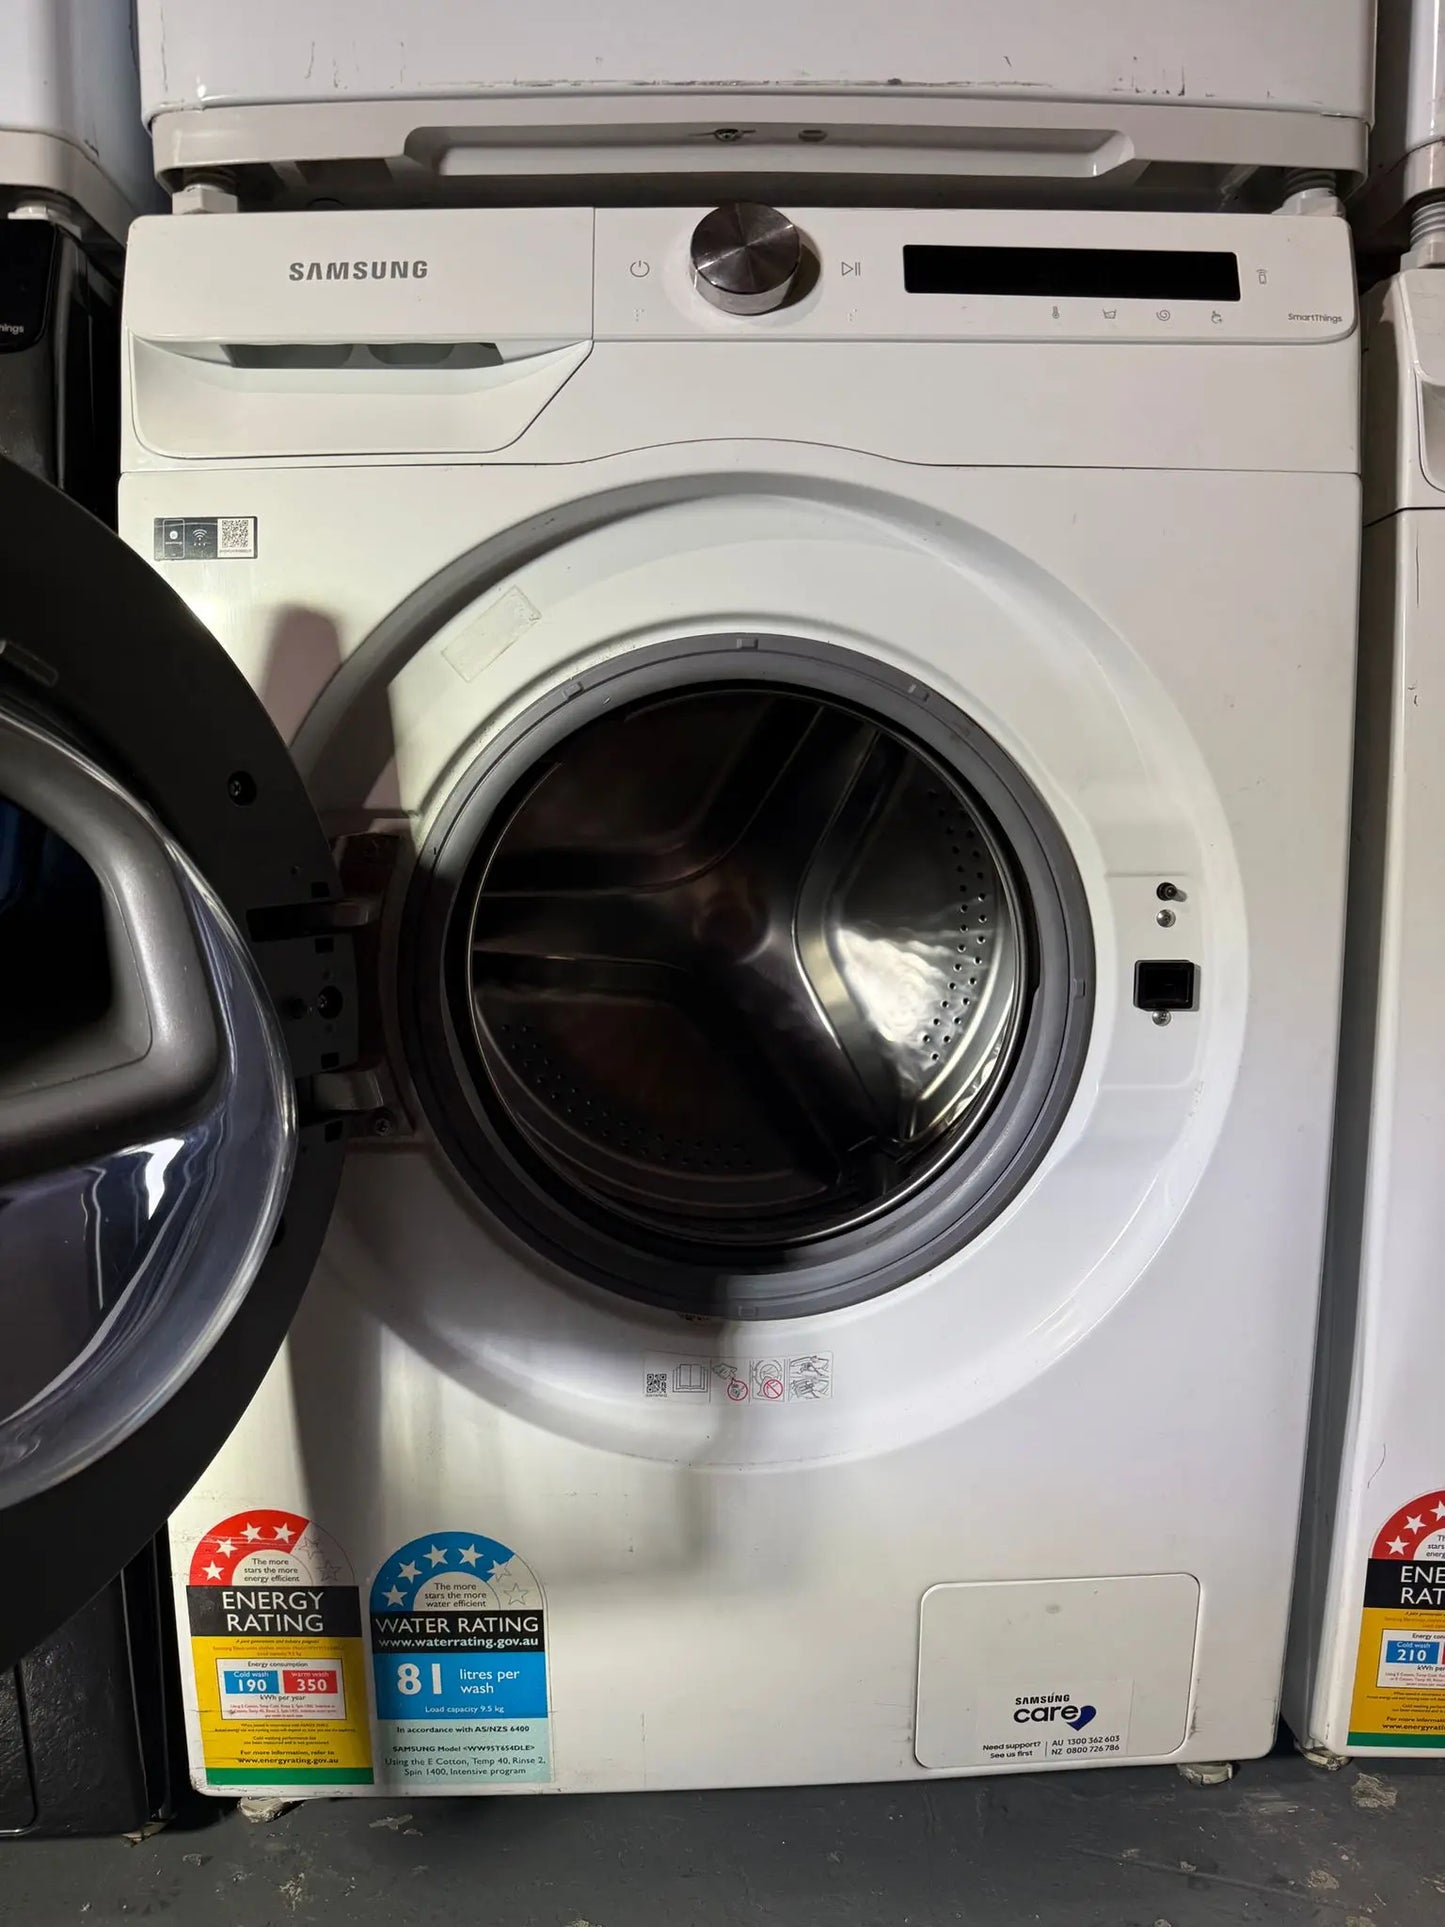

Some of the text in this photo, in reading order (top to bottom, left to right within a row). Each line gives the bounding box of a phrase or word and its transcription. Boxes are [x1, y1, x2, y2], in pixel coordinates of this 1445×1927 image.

[288, 260, 428, 282] SAMSUNG
[1287, 313, 1343, 324] SmartThings
[244, 1574, 300, 1583] energy efficient
[434, 1582, 451, 1590] The
[222, 1591, 324, 1610] ENERGY
[447, 1591, 462, 1599] the
[426, 1599, 487, 1608] water efficient
[226, 1614, 324, 1632] RATING
[375, 1616, 539, 1633] WATER RATING
[378, 1636, 539, 1648] www.waterrating.gov.au
[1396, 1649, 1427, 1662] 210
[459, 1668, 520, 1683] litres per
[238, 1679, 267, 1692] 190
[297, 1679, 328, 1692] 350
[460, 1682, 494, 1694] wash
[1015, 1694, 1070, 1705] SAMSUNG
[425, 1705, 505, 1714] Load capacity 9.5 kg
[1013, 1705, 1079, 1723] care
[510, 1725, 530, 1733] 6400
[1068, 1737, 1087, 1745] 1300
[1088, 1736, 1103, 1744] 362
[1104, 1735, 1120, 1743] 603
[982, 1741, 1041, 1751] Need support?
[1066, 1746, 1088, 1754] 0800
[1089, 1745, 1104, 1753] 726
[1104, 1744, 1120, 1752] 786
[385, 1758, 408, 1766] Using
[411, 1757, 425, 1765] the
[427, 1757, 433, 1765] E
[435, 1757, 469, 1766] Cotton,
[472, 1757, 495, 1766] Temp
[512, 1756, 536, 1765] Rinse
[404, 1767, 526, 1776] Spin 1400, Intensive program
